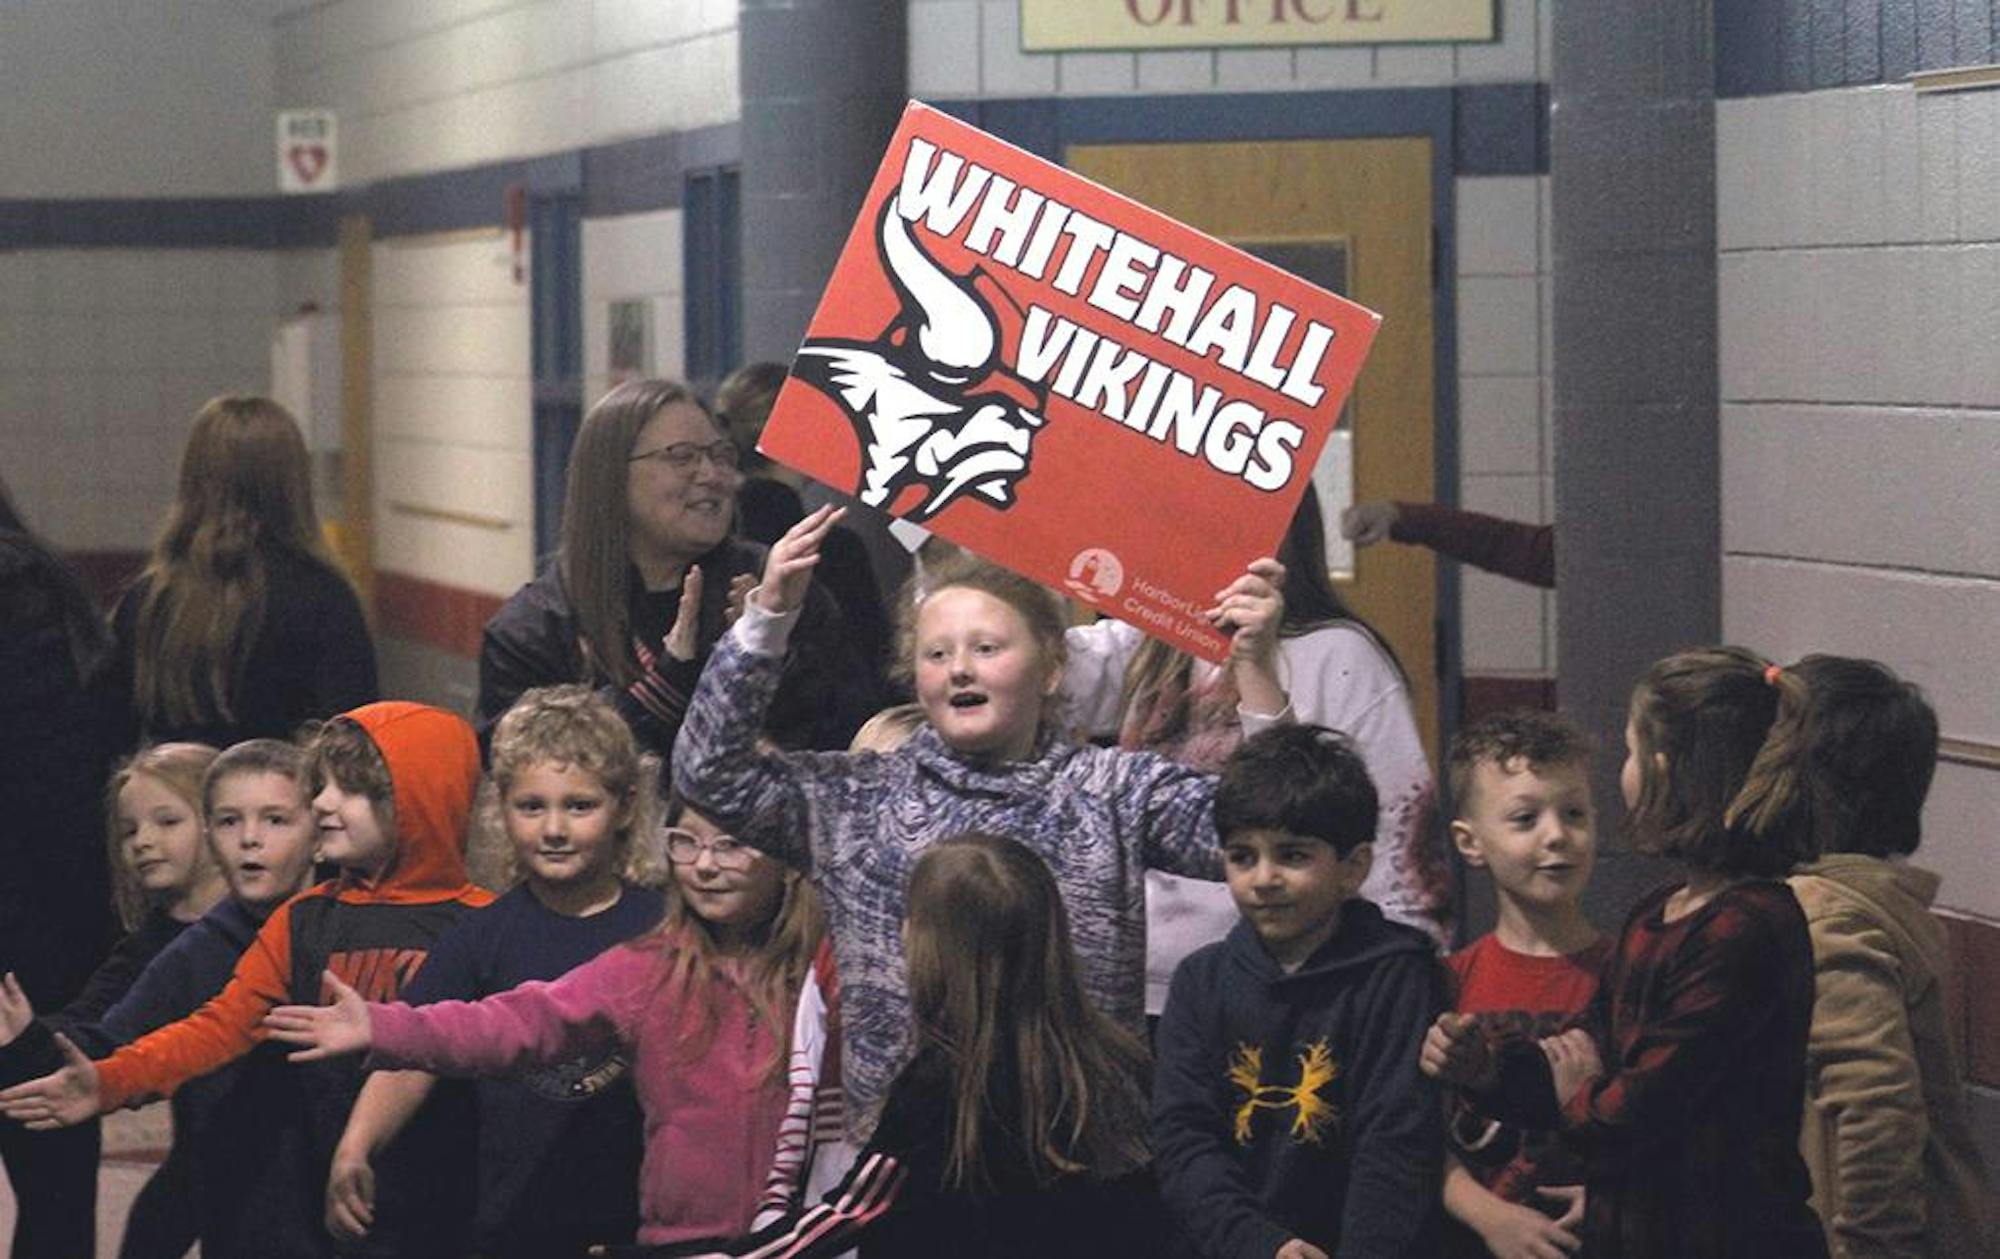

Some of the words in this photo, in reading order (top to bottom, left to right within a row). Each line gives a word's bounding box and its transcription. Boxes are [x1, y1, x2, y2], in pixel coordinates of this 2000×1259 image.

[897, 136, 1334, 408] WHITEHALL
[1016, 304, 1304, 493] VIKINGS
[1123, 597, 1174, 632] Credit
[1175, 620, 1222, 655] Union
